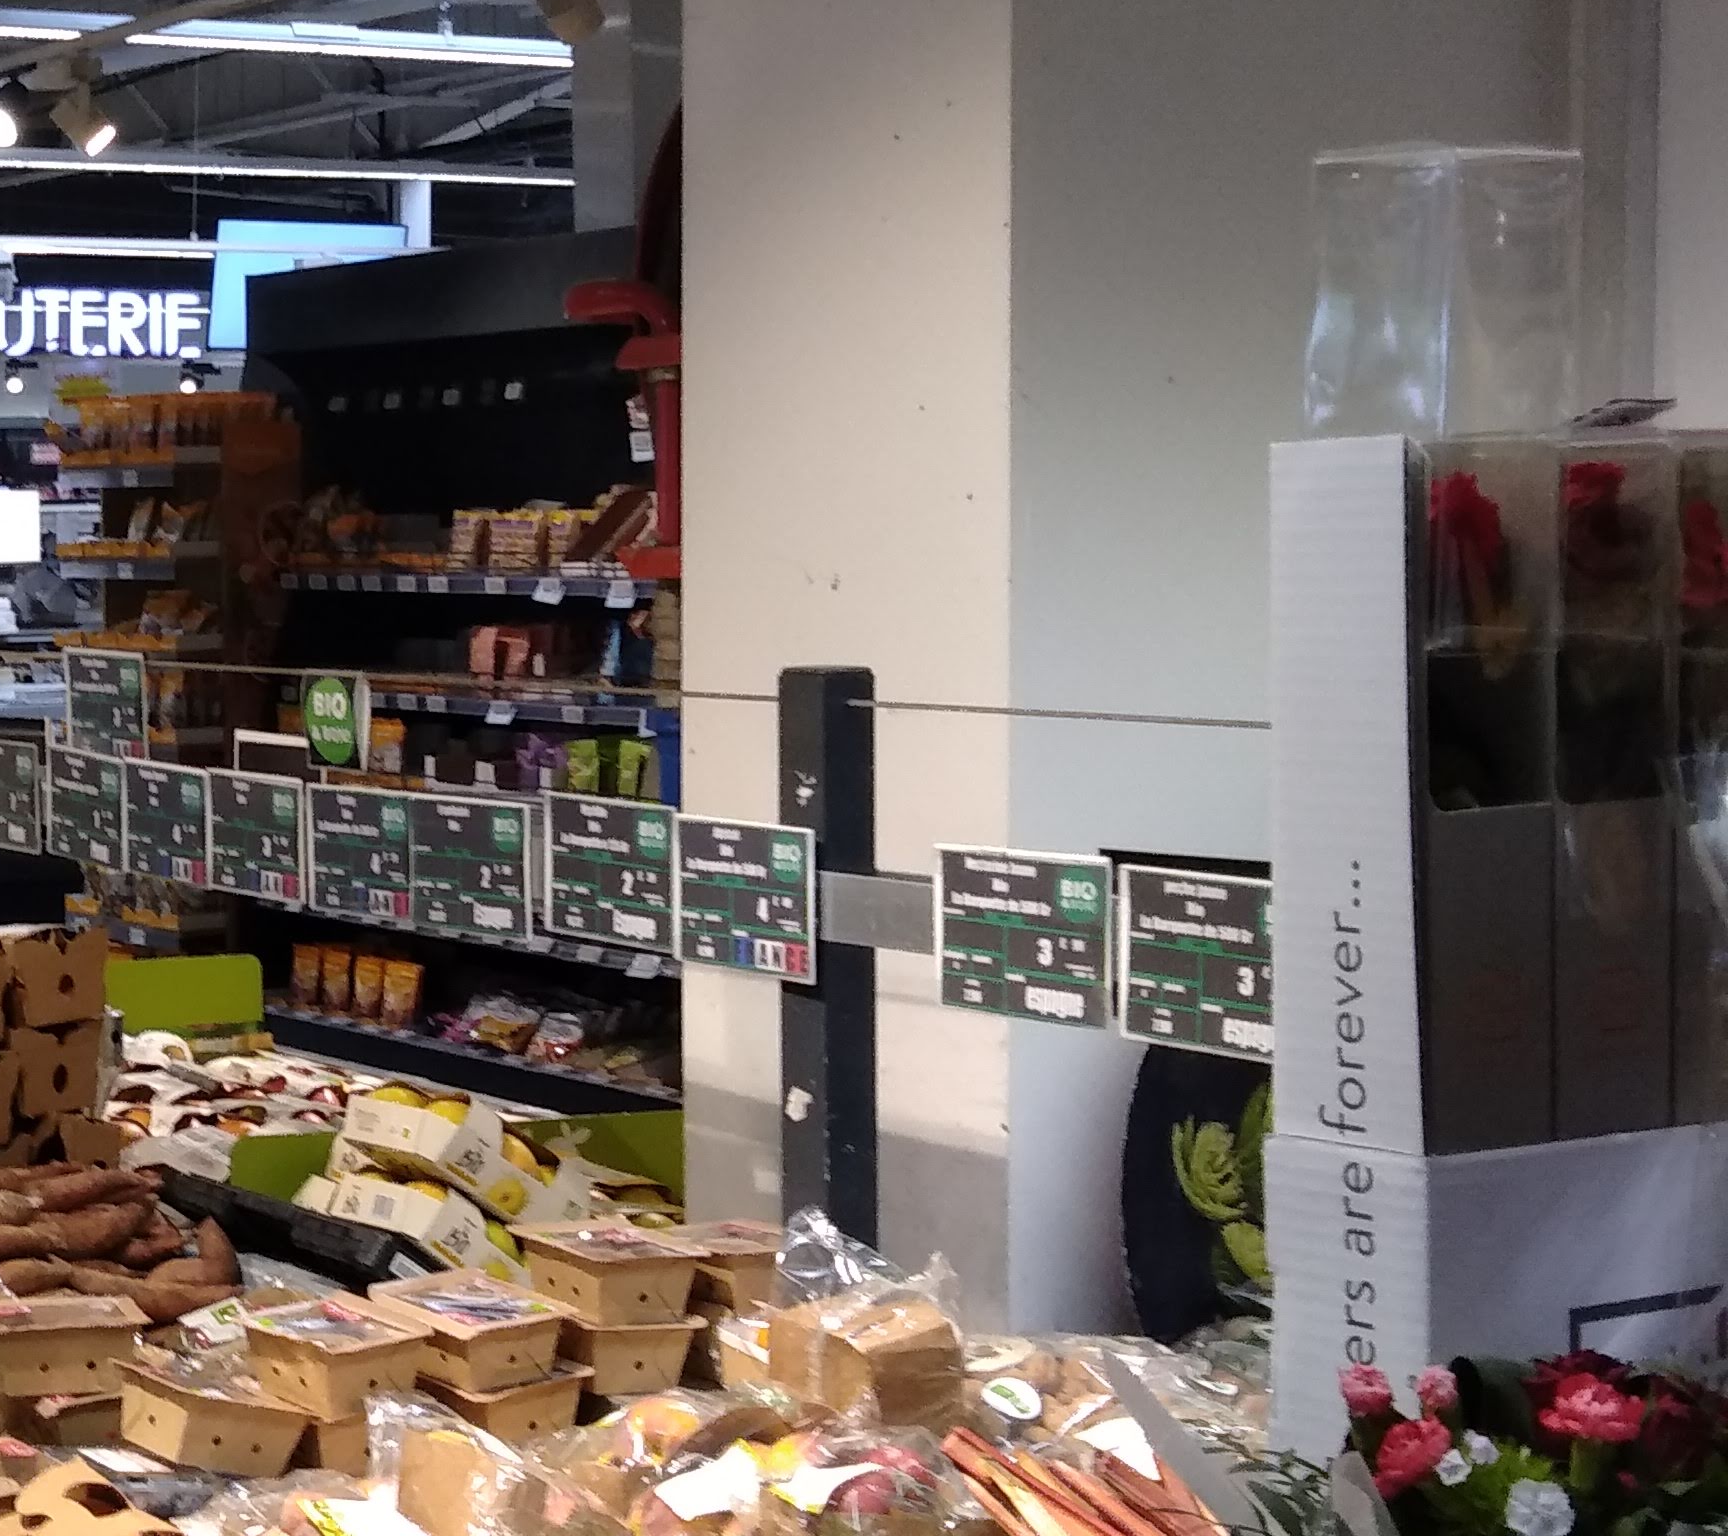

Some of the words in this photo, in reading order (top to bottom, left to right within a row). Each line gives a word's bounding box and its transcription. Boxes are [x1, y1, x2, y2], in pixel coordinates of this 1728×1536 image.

[1059, 878, 1099, 902] BIO
[1035, 936, 1055, 967] 3
[1236, 966, 1255, 997] 3
[1318, 860, 1370, 1135] forever...
[1341, 1161, 1374, 1257] are
